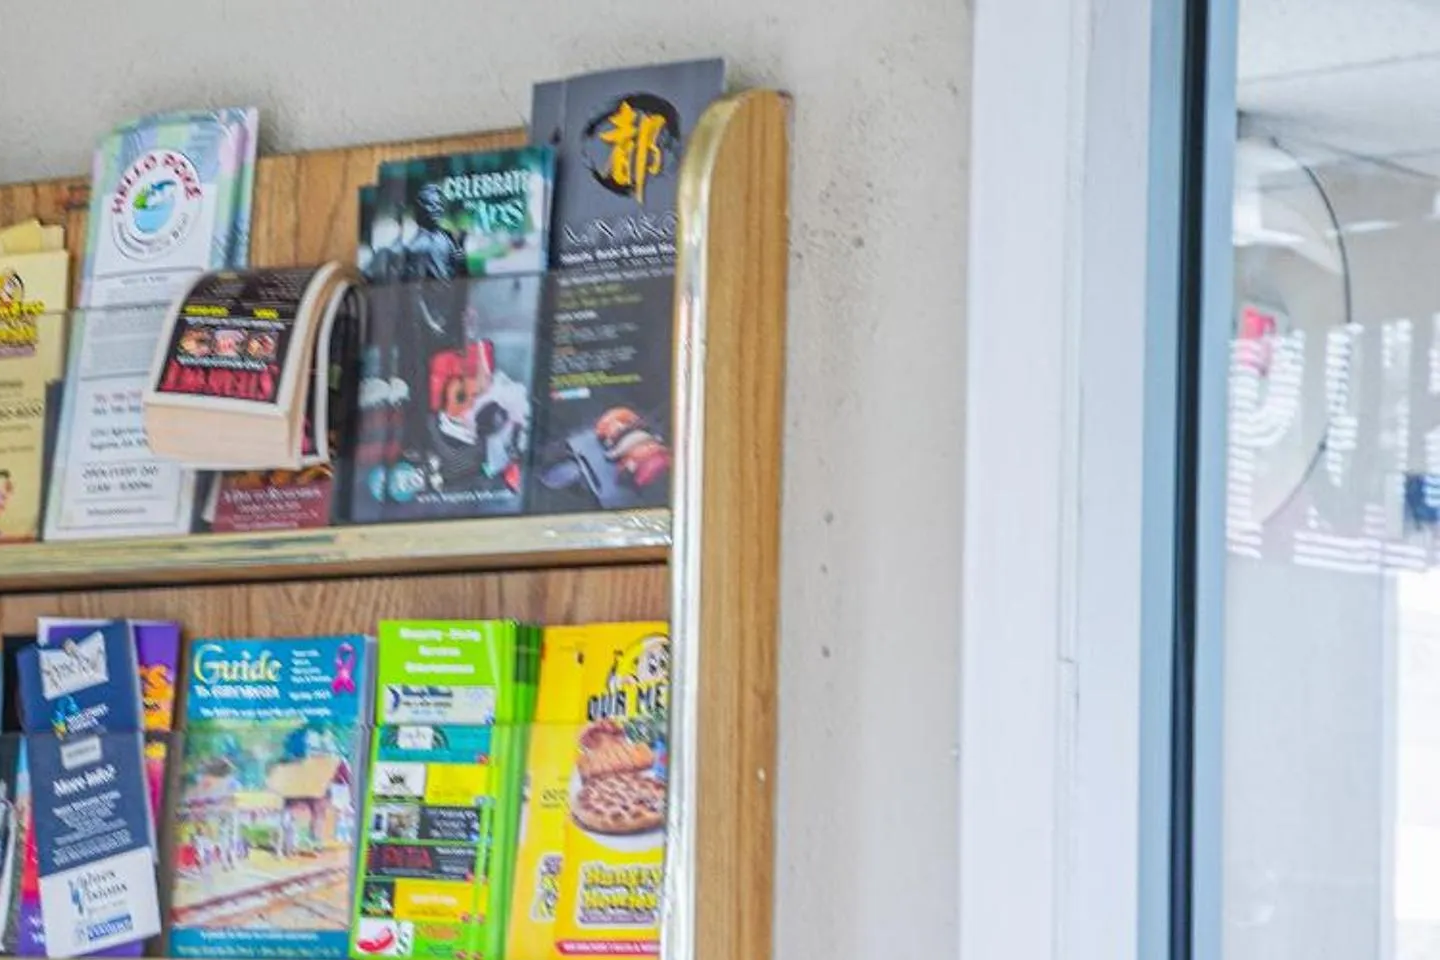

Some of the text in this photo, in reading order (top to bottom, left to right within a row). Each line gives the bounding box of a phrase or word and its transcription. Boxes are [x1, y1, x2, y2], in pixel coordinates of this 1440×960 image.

[599, 95, 667, 203] 都
[111, 154, 158, 213] HELLO
[193, 645, 282, 686] Guide
